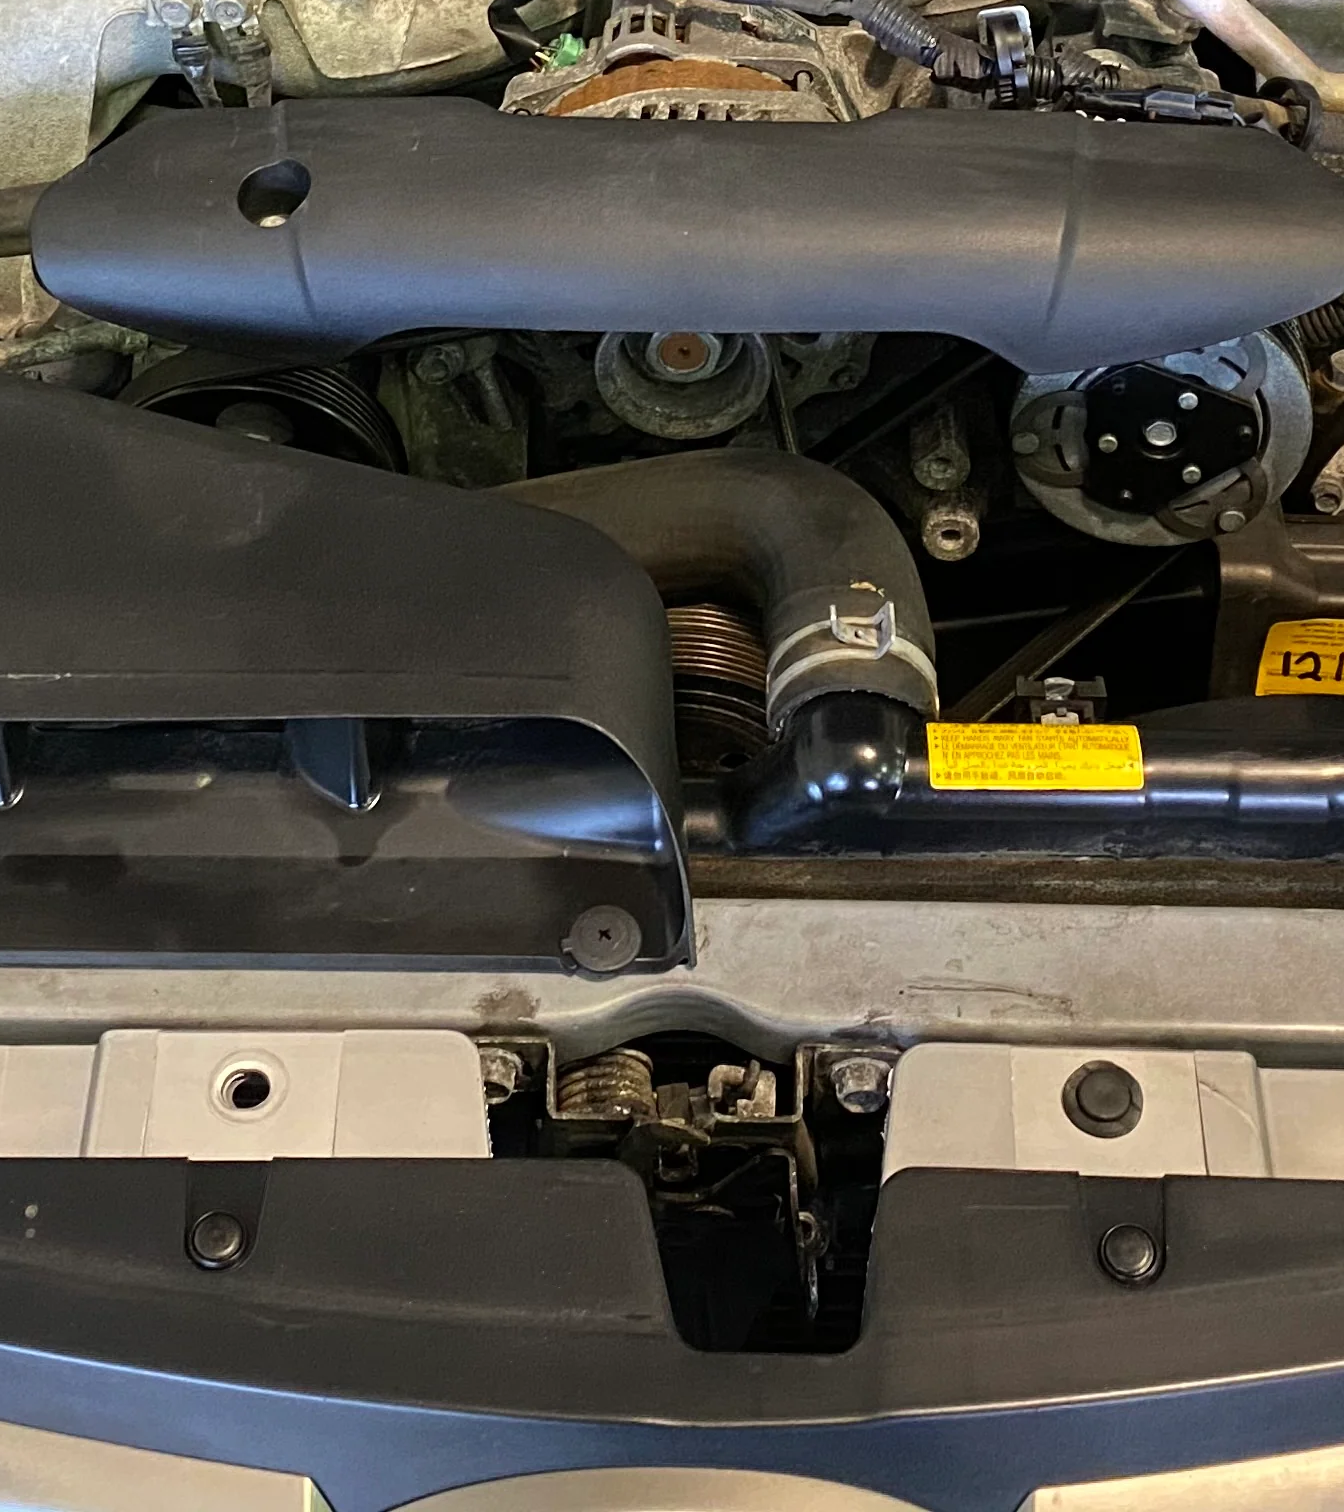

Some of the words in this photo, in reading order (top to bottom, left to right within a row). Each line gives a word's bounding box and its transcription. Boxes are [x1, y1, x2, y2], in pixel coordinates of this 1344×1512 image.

[941, 735, 960, 743] KEEP
[962, 735, 990, 743] HANDS
[992, 735, 1015, 743] AWAY
[1018, 735, 1033, 743] FAN
[1036, 735, 1065, 744] STARTS
[963, 751, 1005, 760] APPROCHEZ
[1007, 751, 1022, 760] PAS
[1023, 751, 1036, 760] LES
